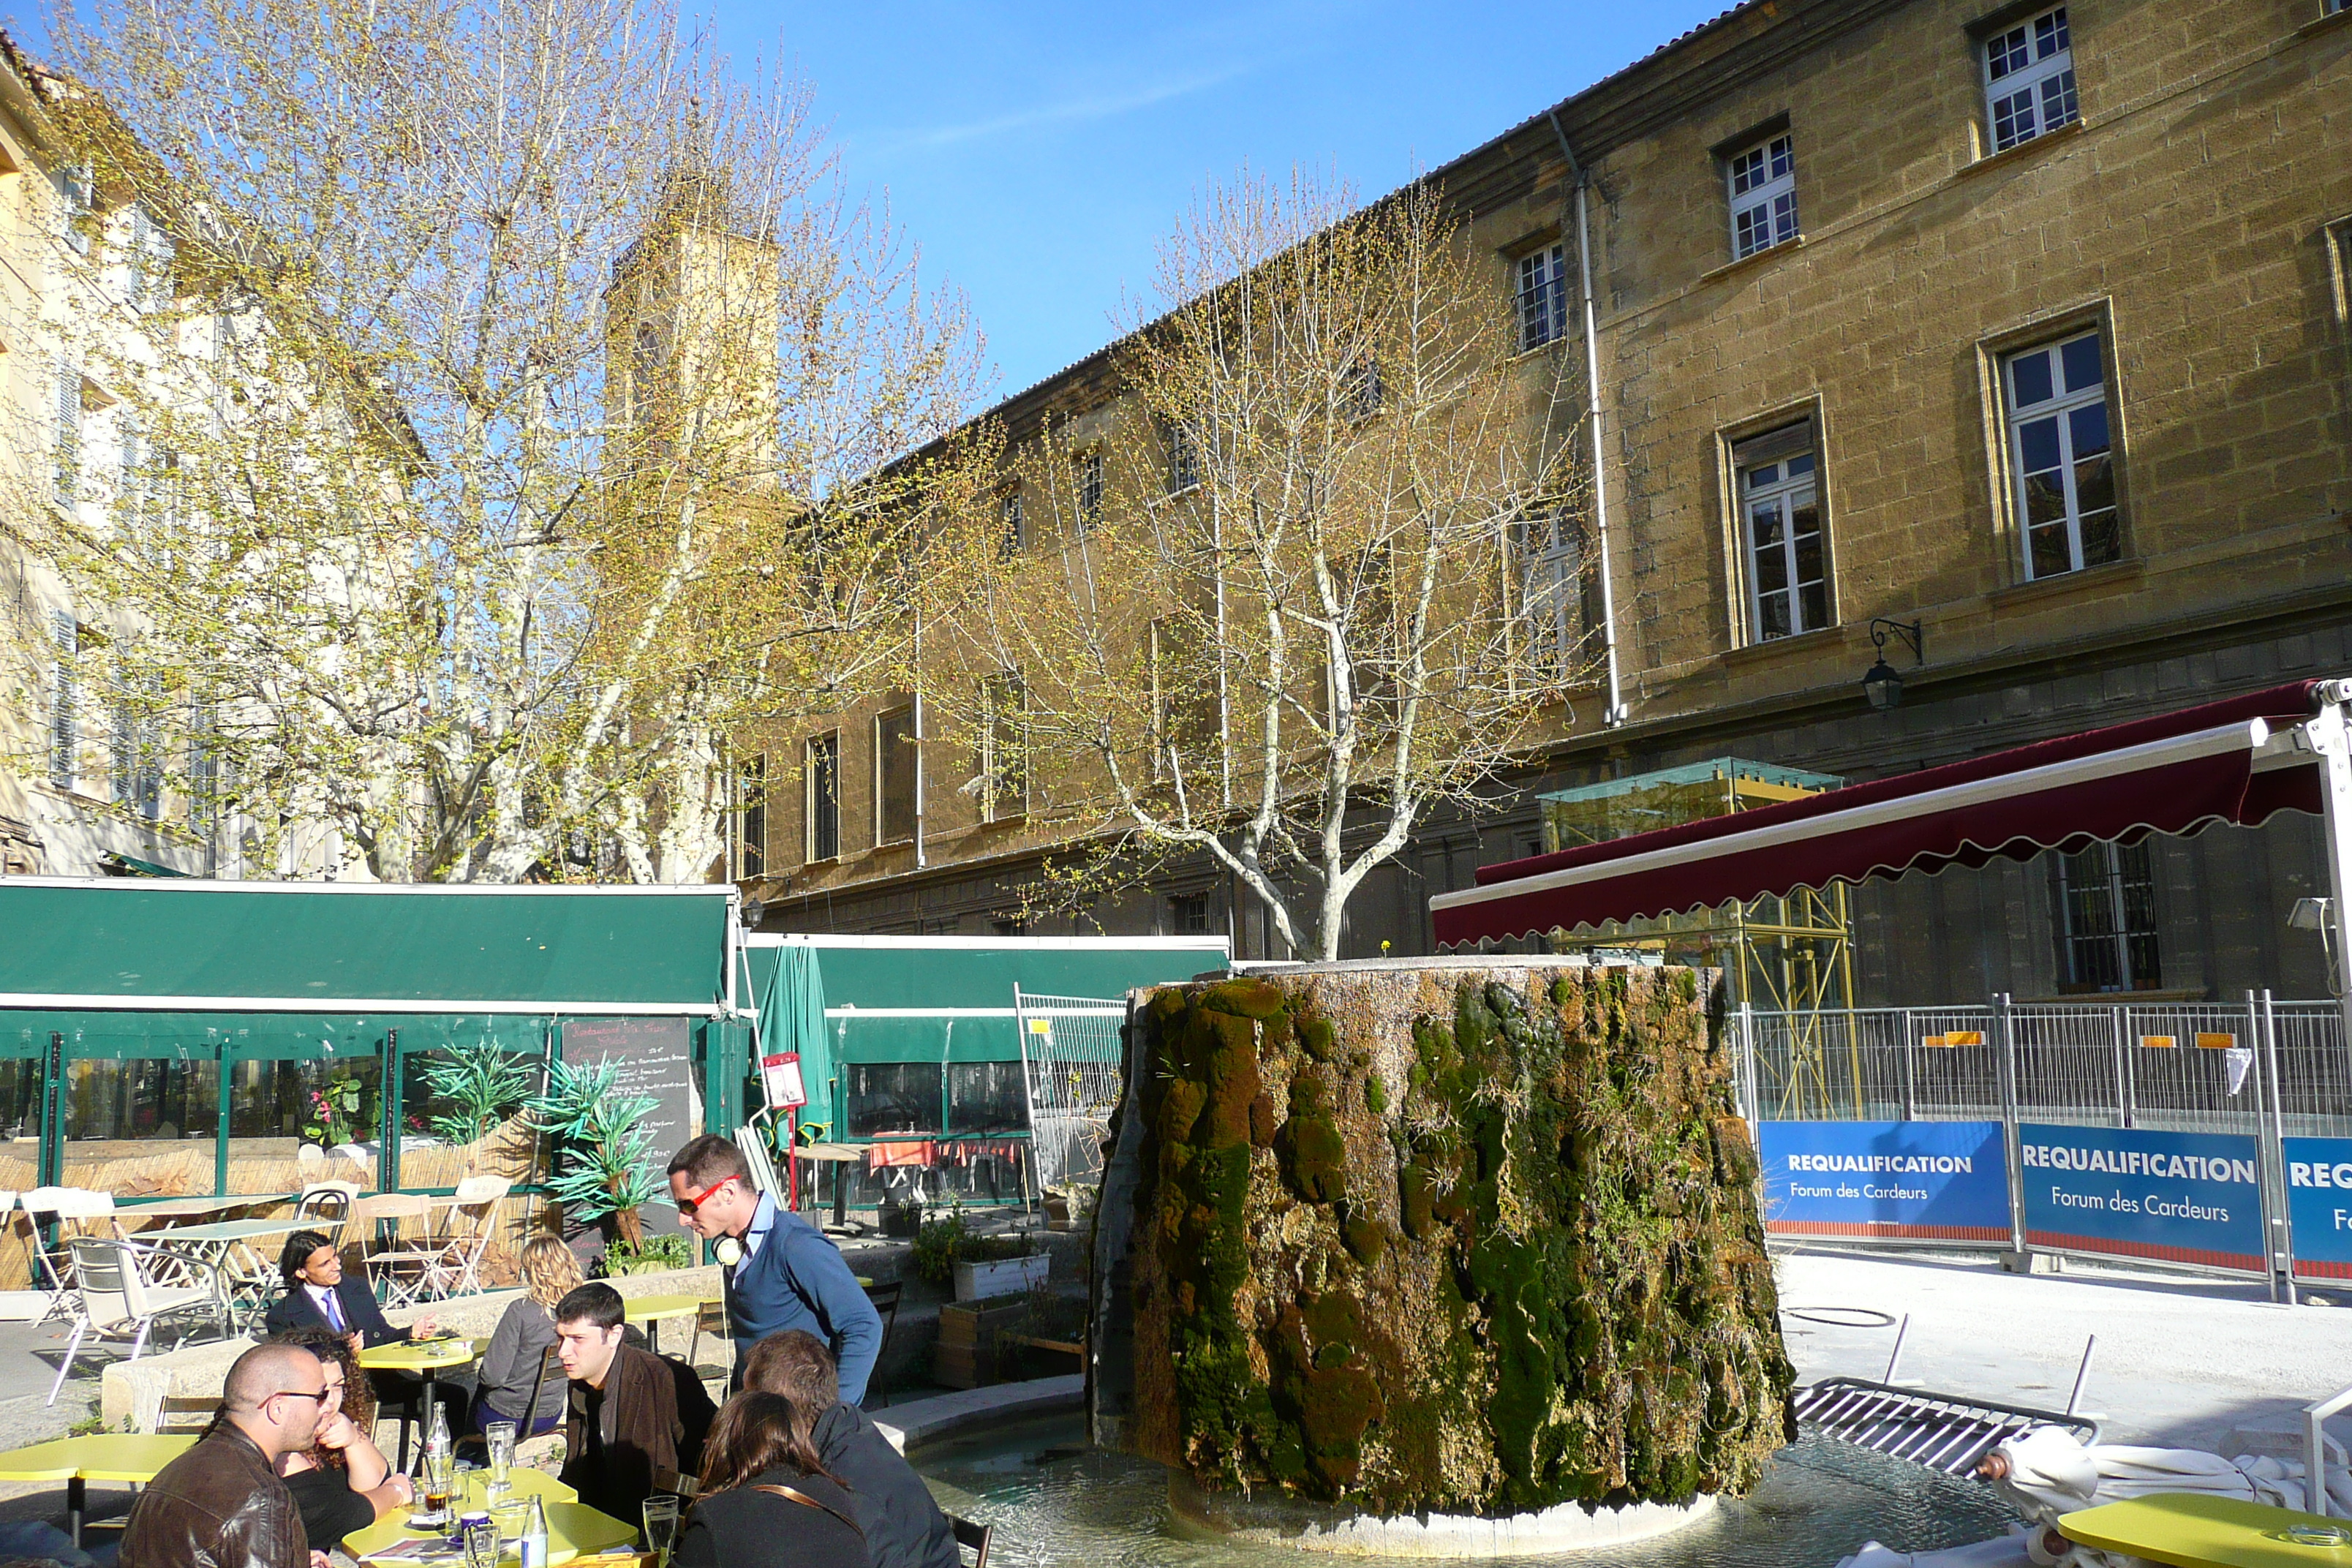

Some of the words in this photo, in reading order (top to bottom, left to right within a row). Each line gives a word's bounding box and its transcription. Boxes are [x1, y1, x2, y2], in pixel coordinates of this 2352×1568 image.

[1788, 1154, 1972, 1173] REQUALIFICATION
[2022, 1145, 2256, 1184] REQUALIFICATION
[1790, 1183, 1832, 1198] Forum
[1836, 1182, 1860, 1198] des
[1863, 1183, 1928, 1199] Cardeurs
[2051, 1186, 2104, 1210] Forum
[2110, 1189, 2139, 1213] des
[2144, 1194, 2229, 1222] Cardeurs
